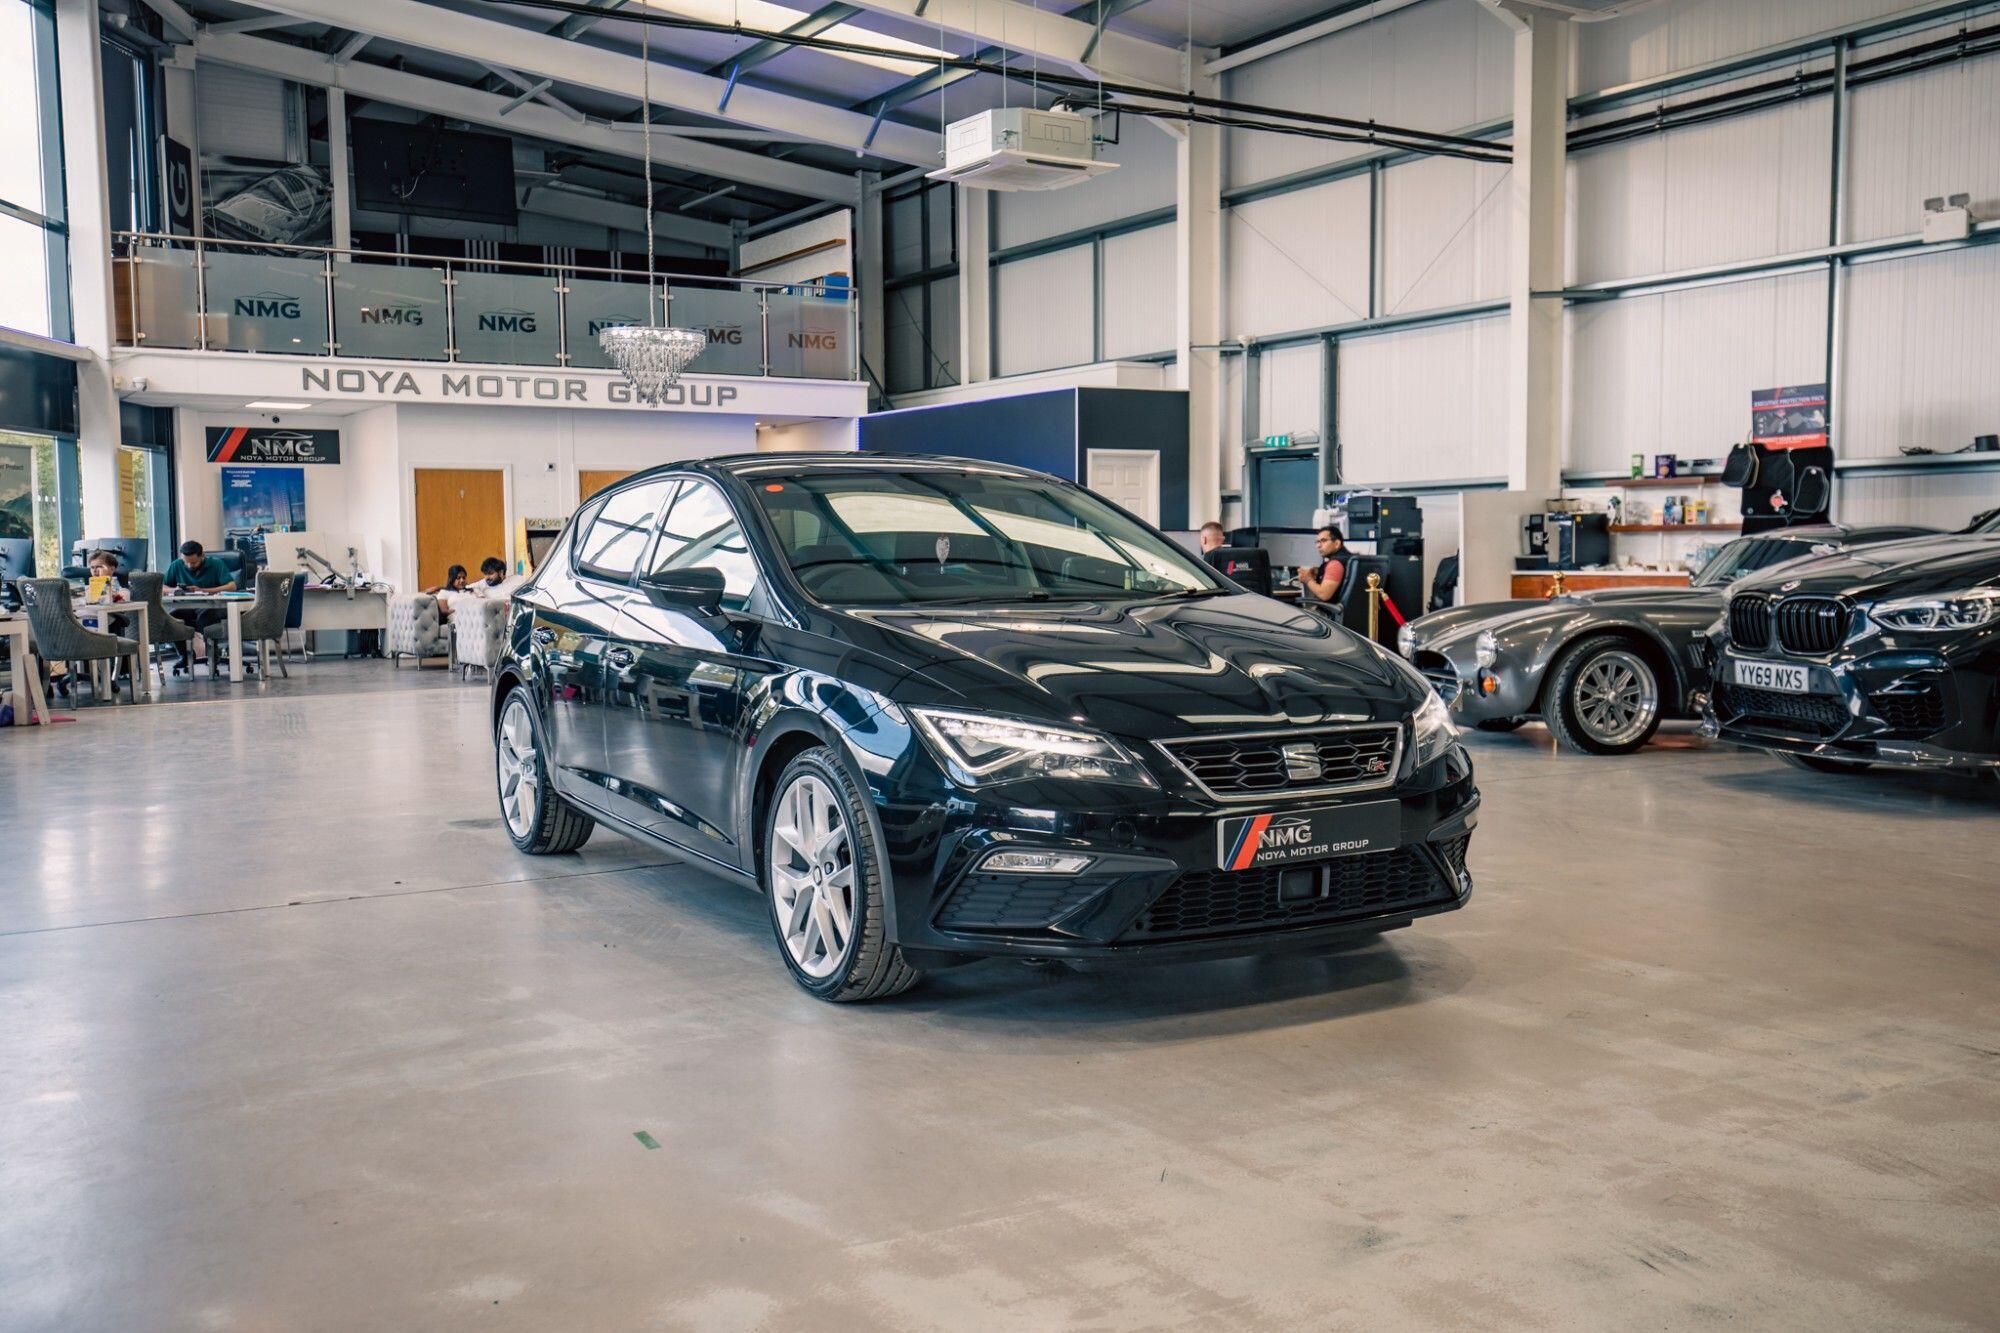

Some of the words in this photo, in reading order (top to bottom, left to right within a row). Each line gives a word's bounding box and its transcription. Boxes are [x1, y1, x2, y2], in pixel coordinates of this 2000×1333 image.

[234, 299, 301, 319] NMG
[361, 308, 423, 326] NMG
[478, 314, 537, 333] NMG
[702, 327, 742, 345] MG
[788, 333, 837, 350] NMG
[302, 367, 421, 395] NOYA
[442, 373, 588, 402] MOTOR
[608, 381, 737, 406] GOUP
[251, 438, 315, 456] NMG
[1740, 665, 1772, 686] YY69
[1775, 669, 1803, 690] NXS
[1258, 825, 1313, 849] NMG
[1257, 850, 1287, 861] NOYA
[1290, 844, 1329, 857] MOTOR
[1332, 839, 1369, 852] GROUP
